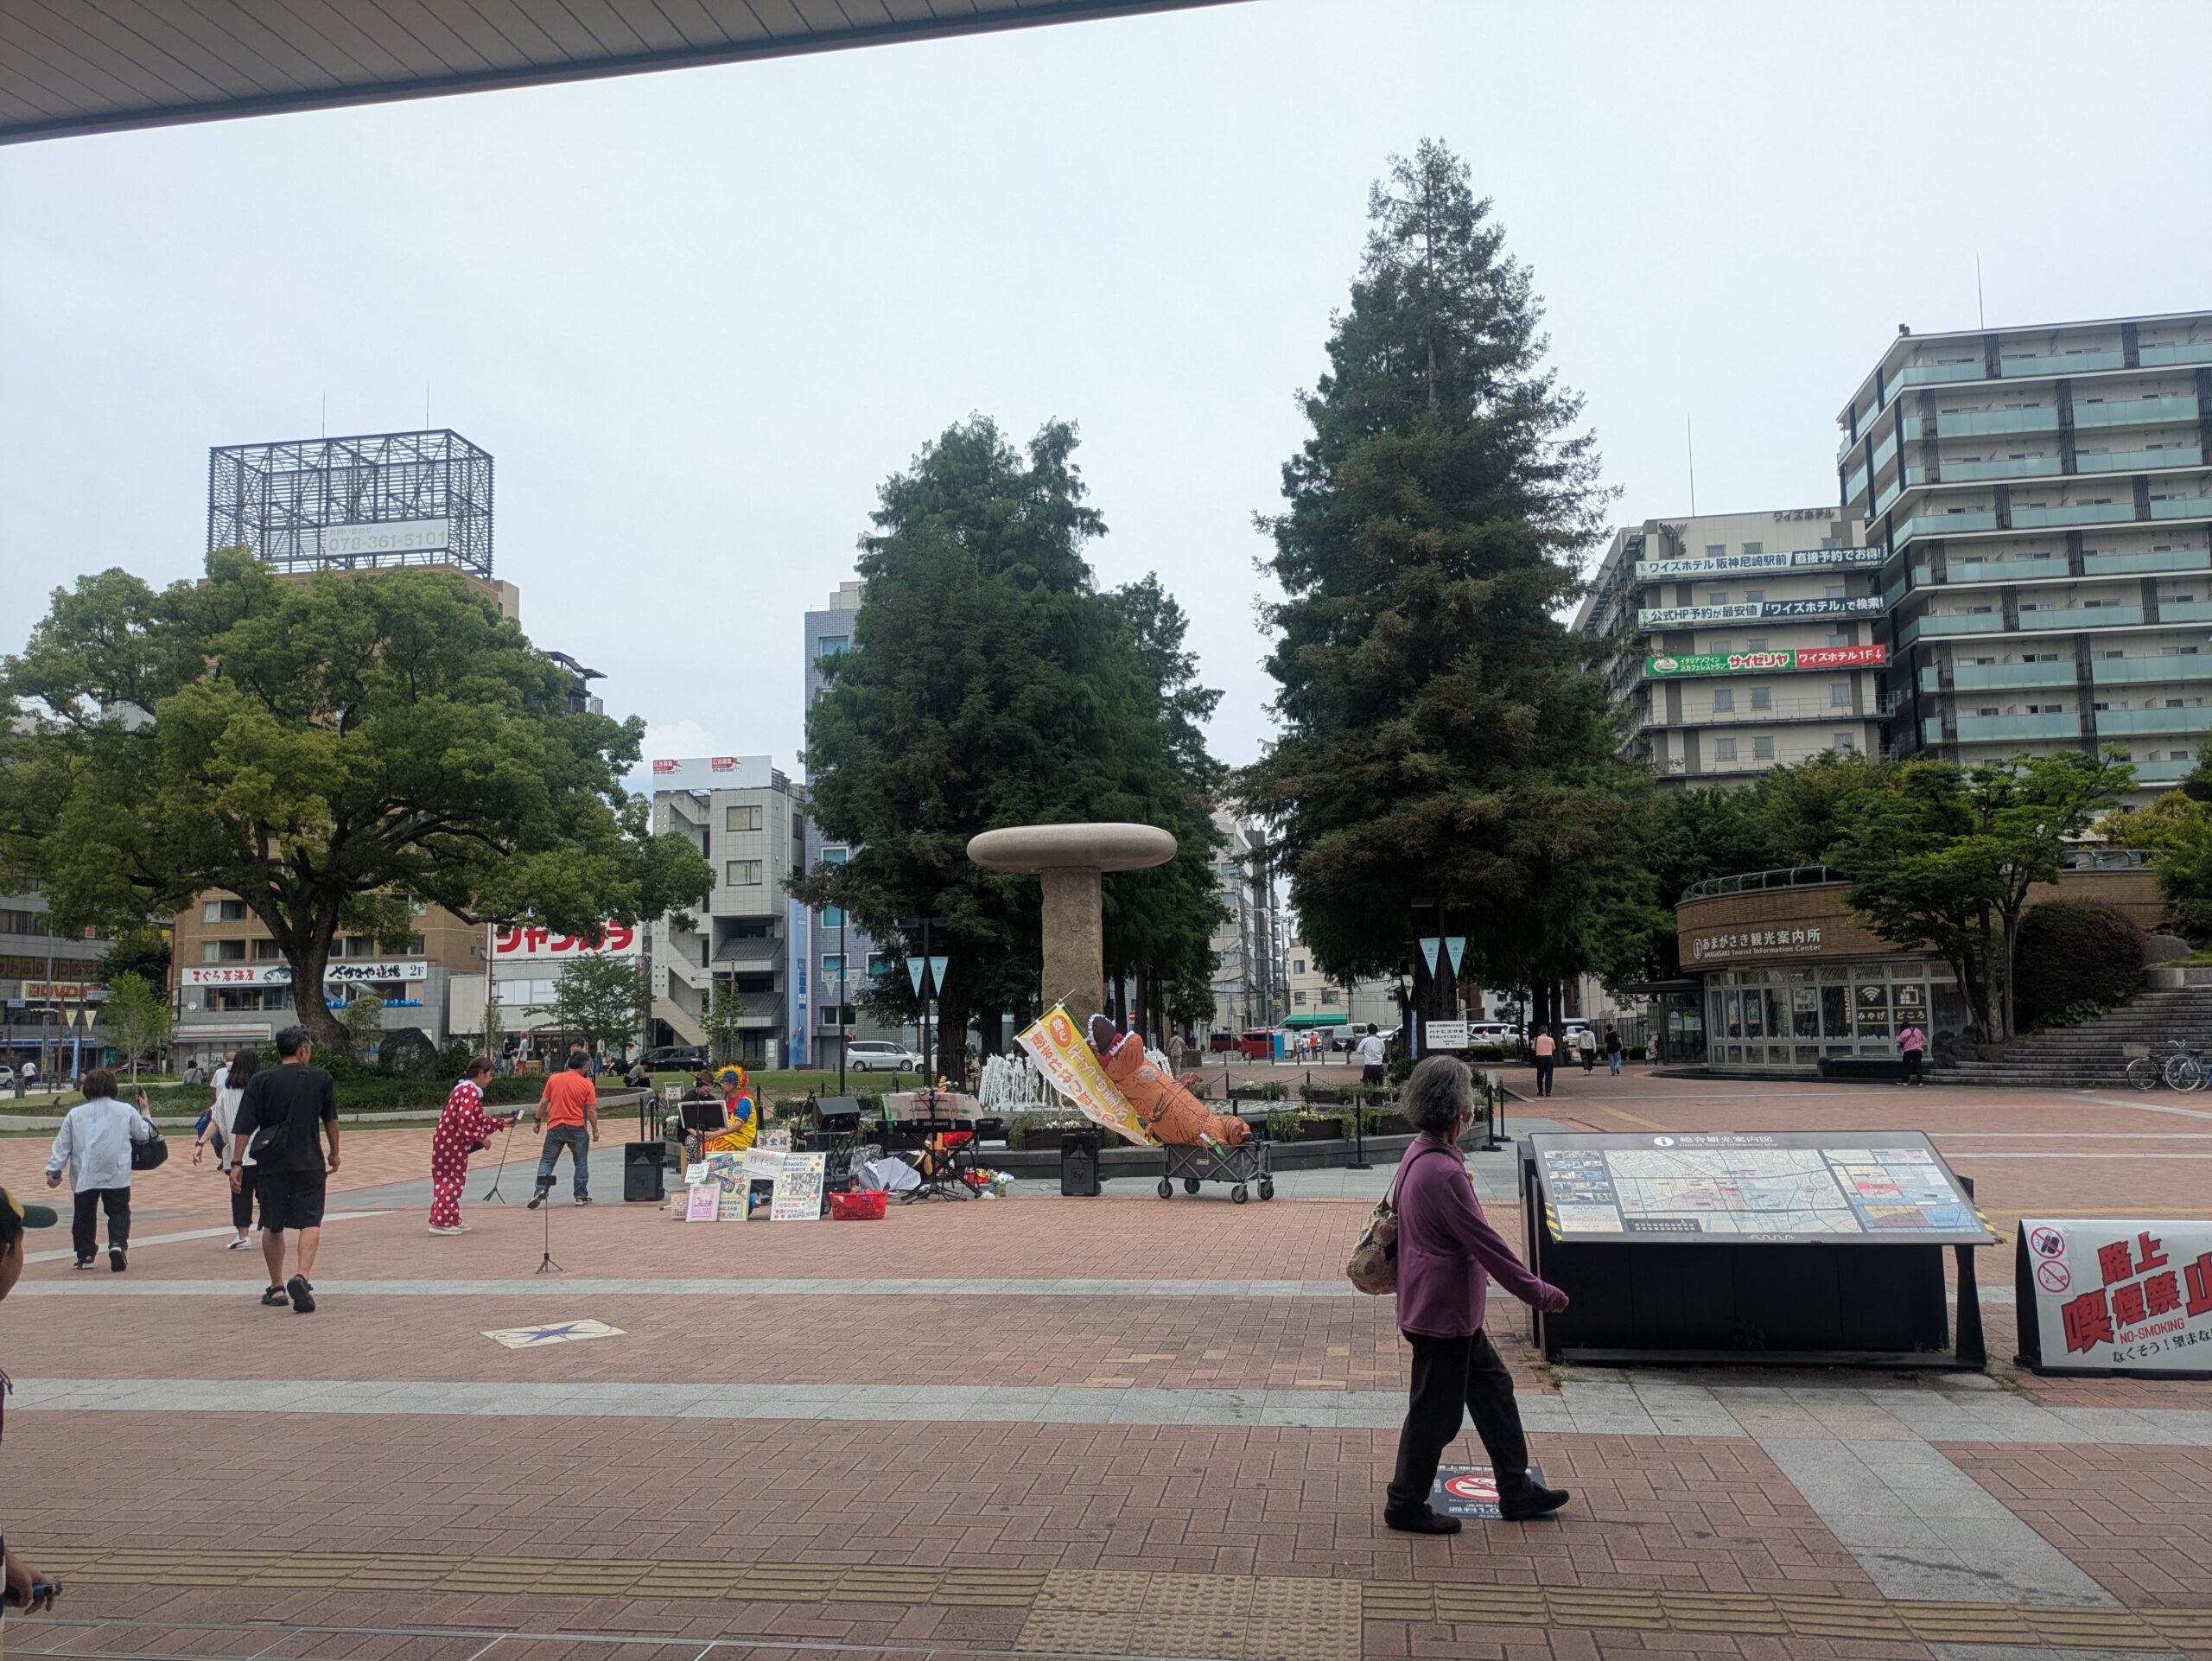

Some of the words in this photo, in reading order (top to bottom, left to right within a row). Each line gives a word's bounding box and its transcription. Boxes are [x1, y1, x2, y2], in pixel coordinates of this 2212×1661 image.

[1774, 508, 1835, 521] ワイズホテル
[328, 531, 446, 551] 078-361-5101
[1649, 559, 1714, 573] ワイズホテル
[1716, 553, 1787, 570] 阪神尼崎駅前
[1651, 605, 1758, 622] 公式HP予約が最安値
[1728, 652, 1789, 669] サイゼリヤ
[1702, 928, 1821, 950] あまがさき観光案内所
[1753, 945, 1794, 954] Information
[193, 970, 256, 983] まぐろ居酒屋
[329, 964, 401, 979] さかなや道場
[410, 964, 424, 976] 2F
[1843, 986, 1852, 1024] SOUVENIR
[1858, 1010, 1885, 1021] みやげ
[1897, 1010, 1925, 1020] どころ
[2097, 1231, 2169, 1287] 路上
[2120, 1317, 2185, 1345] NO-SMOKING
[2112, 1328, 2212, 1363] なくそう！望まな
